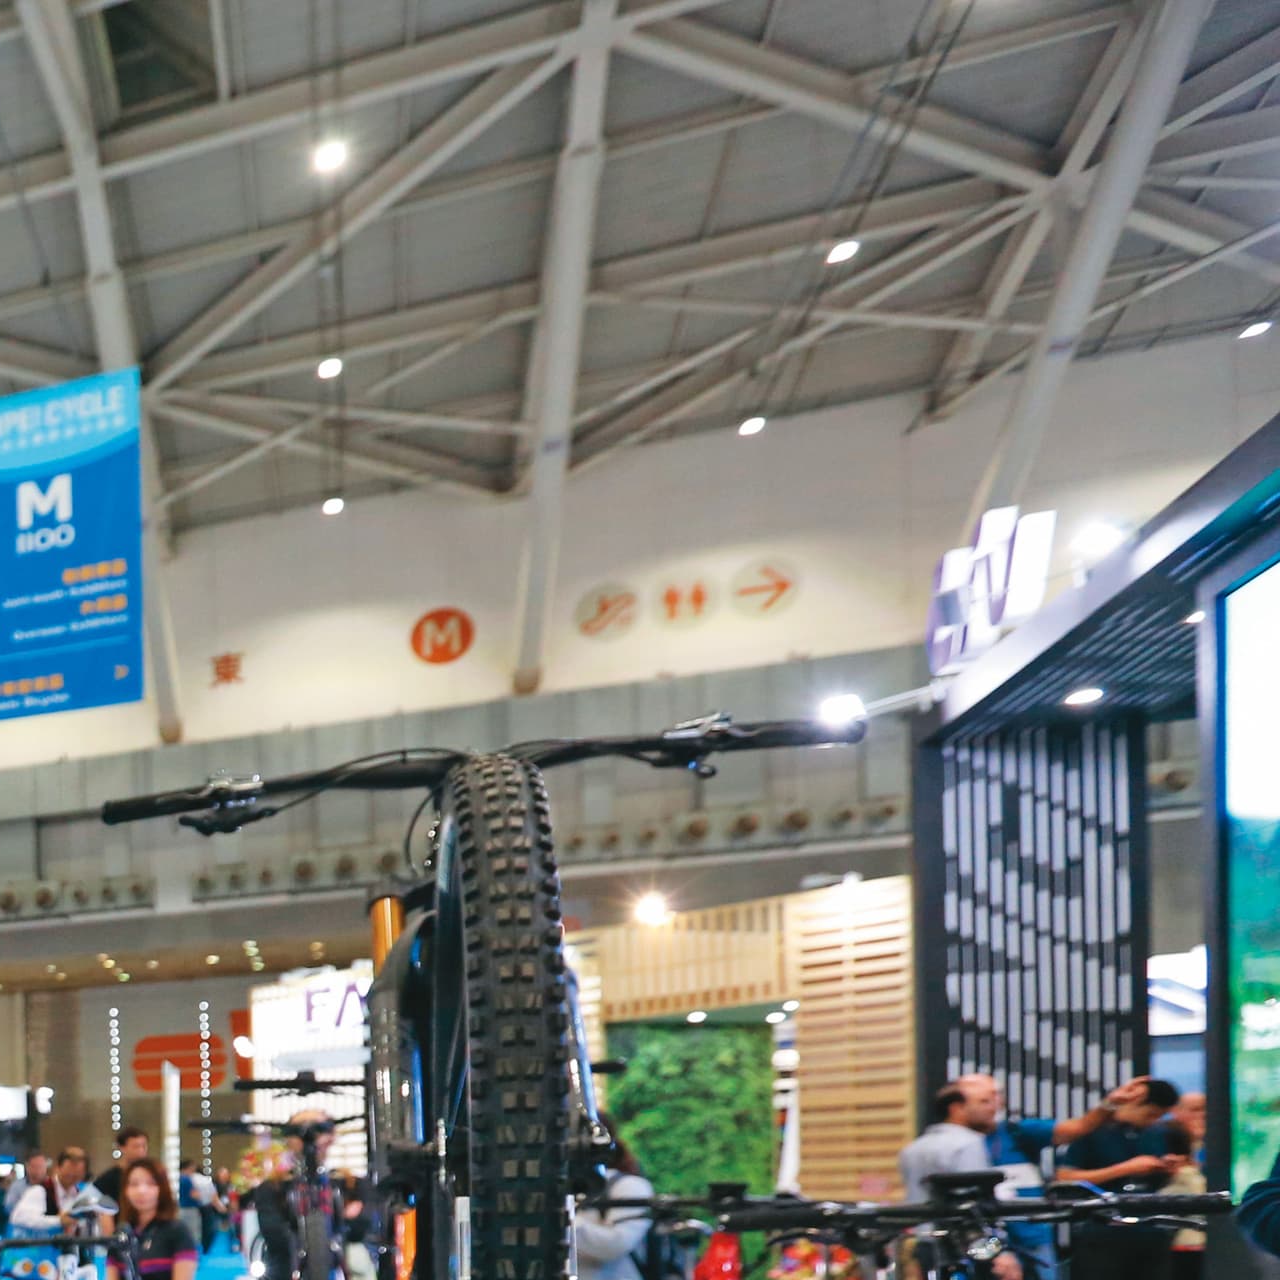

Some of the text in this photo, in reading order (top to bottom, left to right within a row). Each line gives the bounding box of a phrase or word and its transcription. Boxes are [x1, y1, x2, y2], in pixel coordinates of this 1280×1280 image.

[44, 384, 125, 427] CYCLE
[16, 472, 73, 531] M
[15, 523, 76, 555] 1100
[423, 617, 461, 657] M
